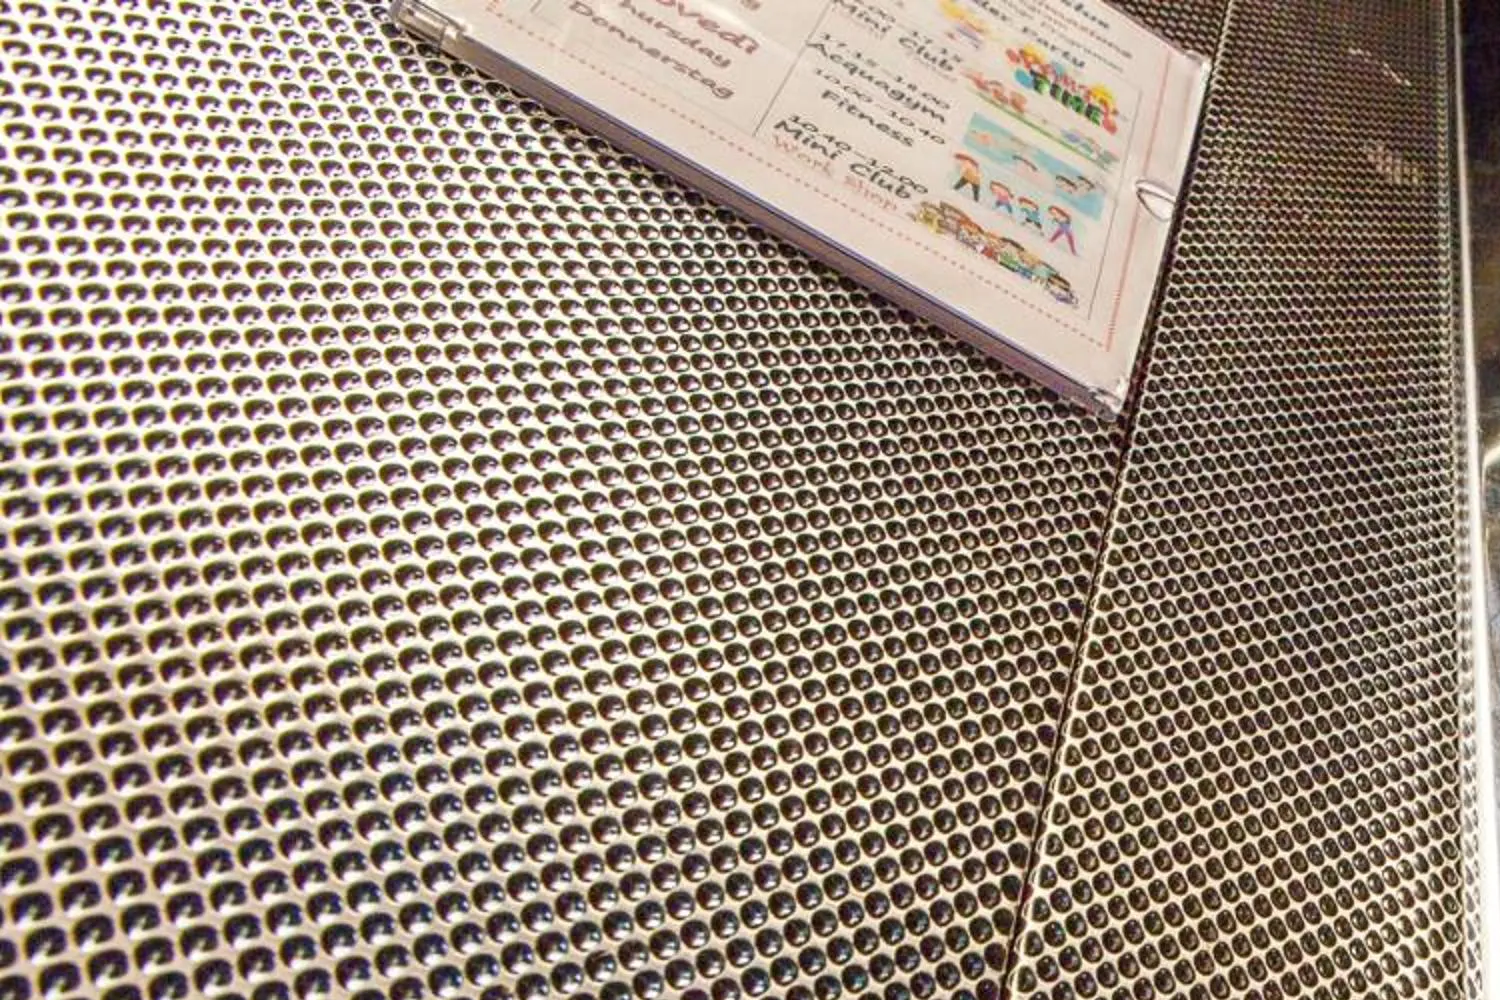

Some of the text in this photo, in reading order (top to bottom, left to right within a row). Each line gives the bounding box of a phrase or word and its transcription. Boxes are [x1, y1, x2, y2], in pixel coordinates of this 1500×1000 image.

[570, 1, 735, 99] Donnerstag
[619, 0, 731, 67] hursday
[806, 41, 946, 123] Acquagym
[822, 90, 915, 147] Fitness
[774, 120, 912, 199] Mini Club
